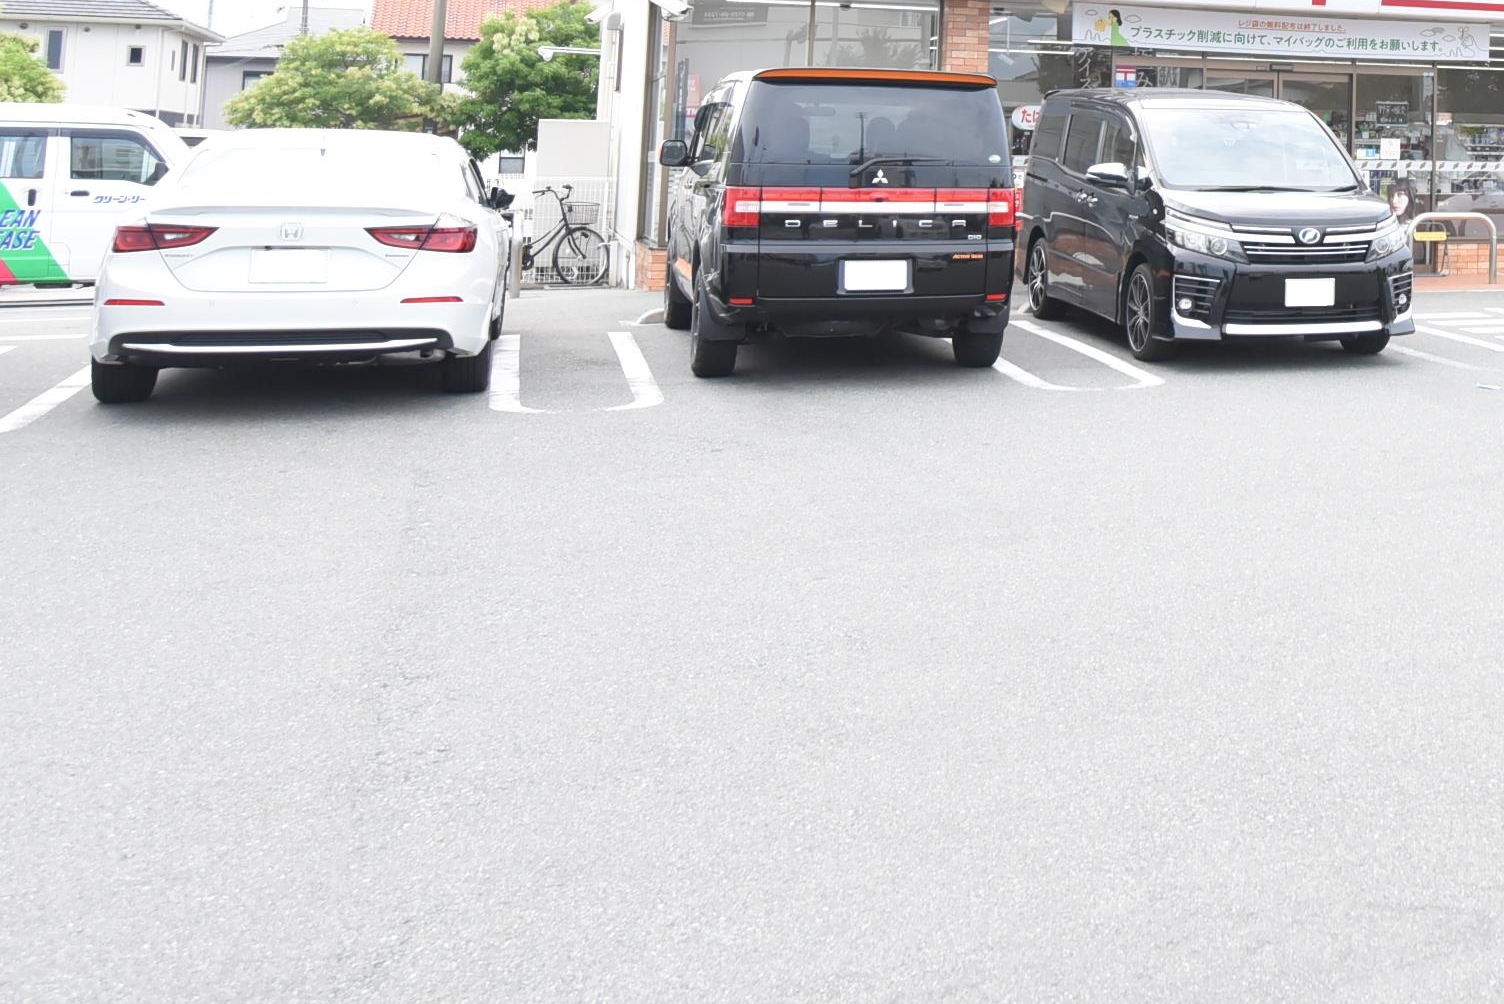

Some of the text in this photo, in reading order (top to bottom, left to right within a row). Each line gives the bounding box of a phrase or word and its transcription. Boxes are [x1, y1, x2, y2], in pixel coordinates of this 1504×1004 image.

[1130, 26, 1444, 53] プラスチック削減に向けて、マイバッグのご利用をお願いします。
[784, 219, 967, 228] DELICA
